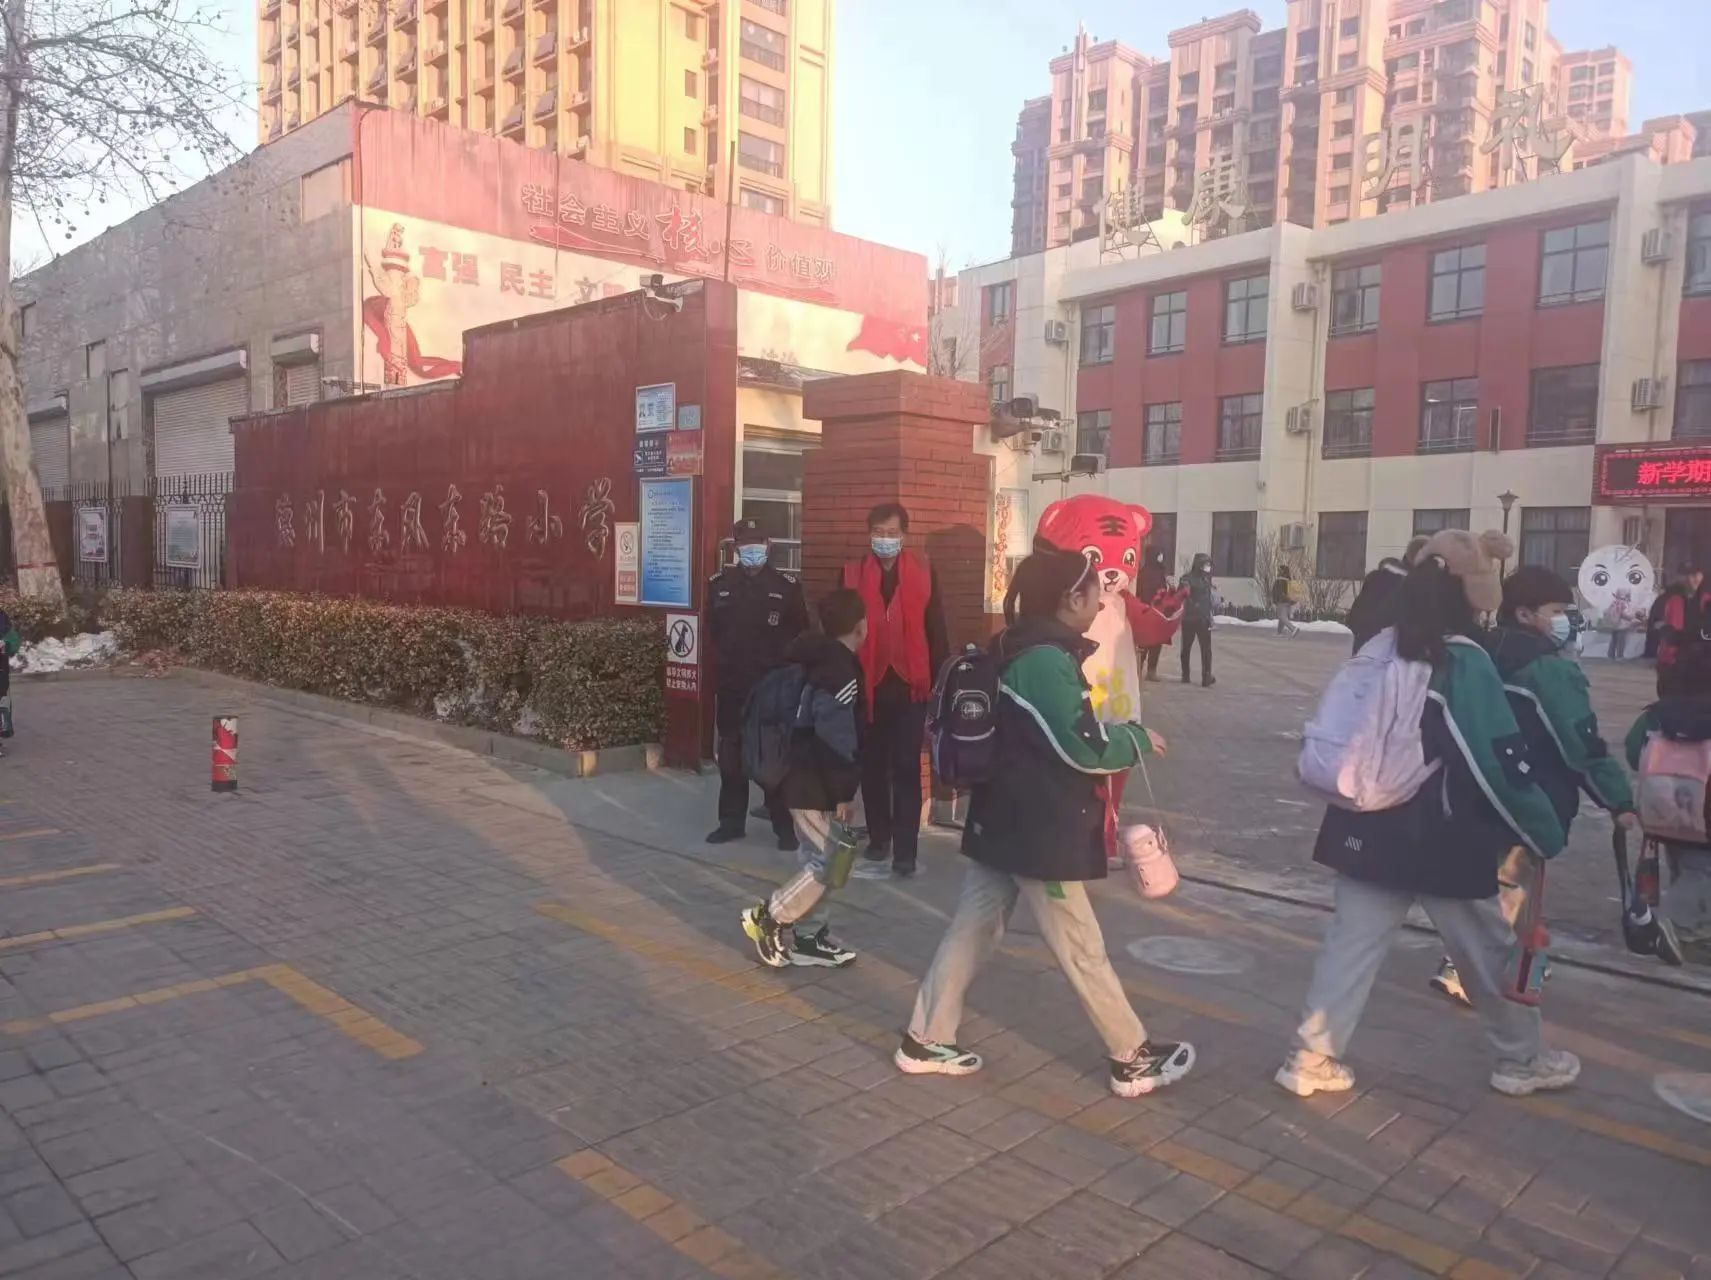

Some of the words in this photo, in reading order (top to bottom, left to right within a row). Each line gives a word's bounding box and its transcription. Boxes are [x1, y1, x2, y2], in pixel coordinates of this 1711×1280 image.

[501, 261, 556, 299] 民主
[1638, 459, 1711, 486] 新学期
